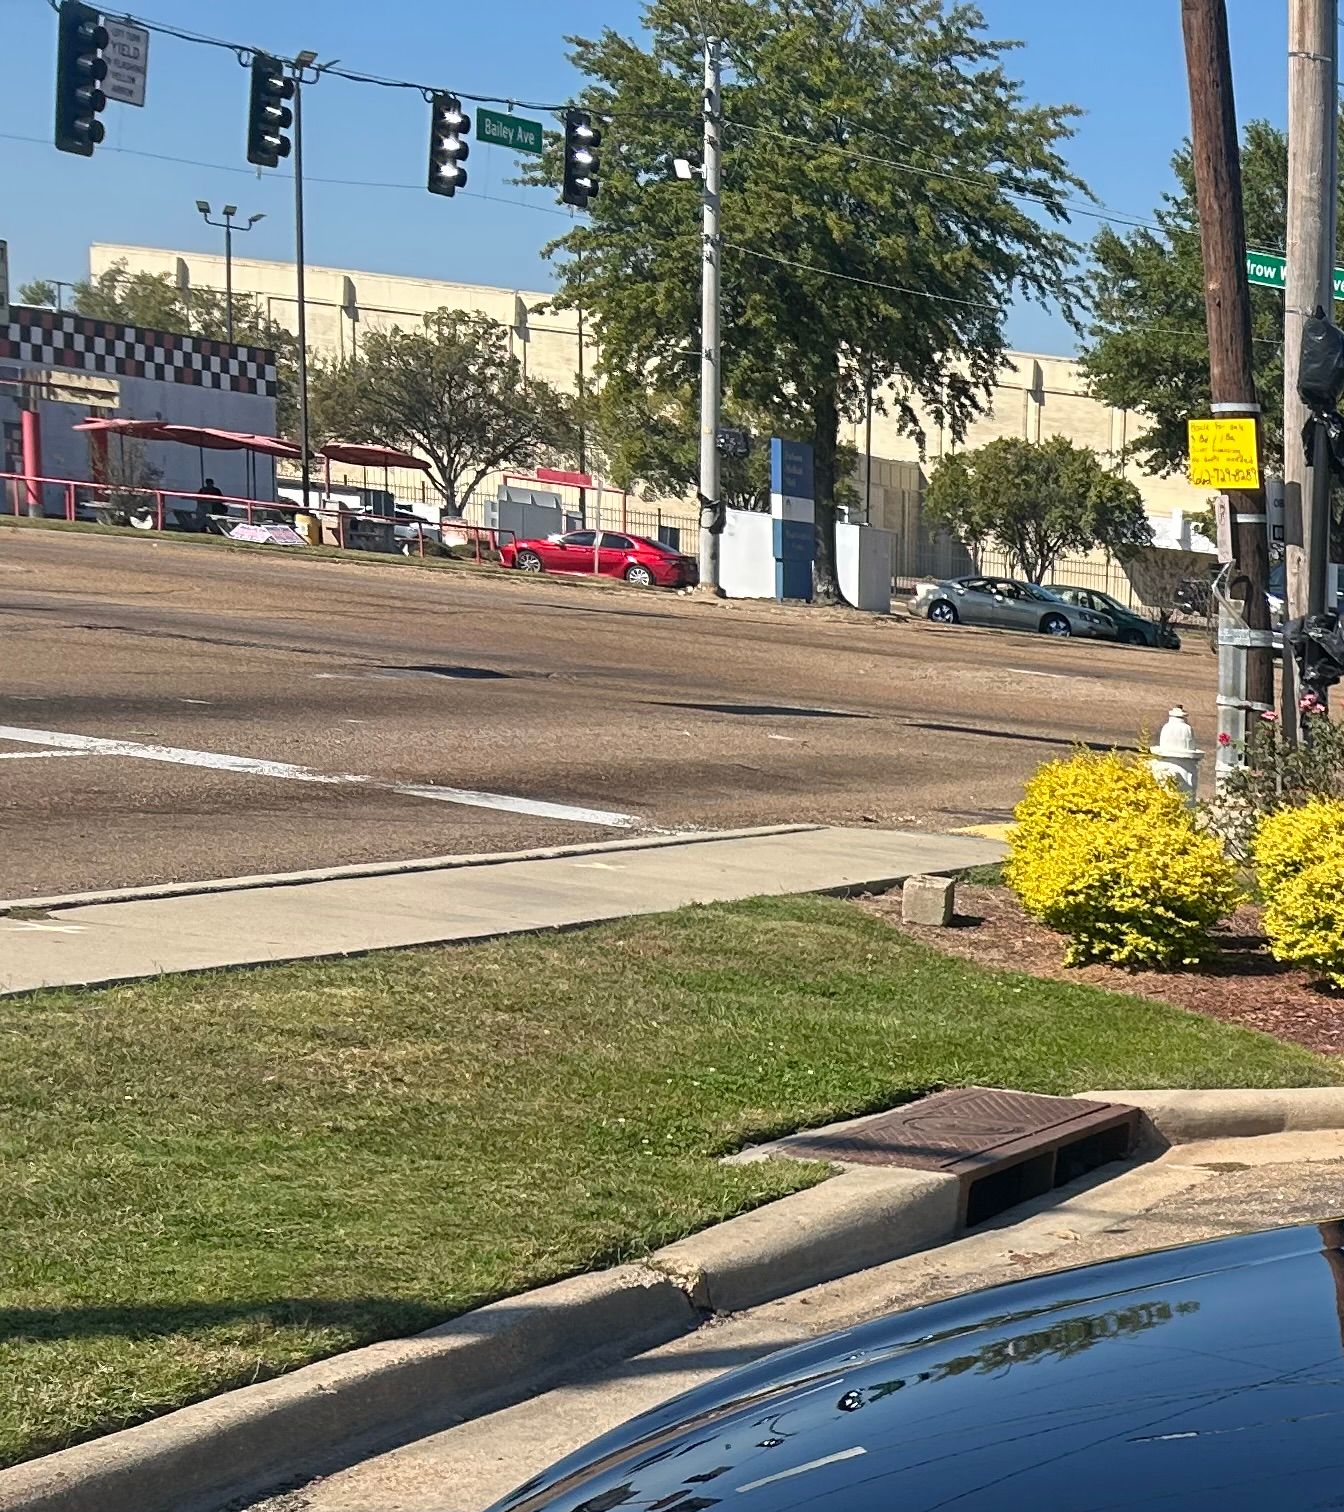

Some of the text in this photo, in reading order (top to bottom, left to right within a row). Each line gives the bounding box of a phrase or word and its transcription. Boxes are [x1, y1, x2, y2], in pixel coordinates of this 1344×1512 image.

[111, 40, 140, 60] YIELD
[484, 118, 535, 146] Bailey Ave
